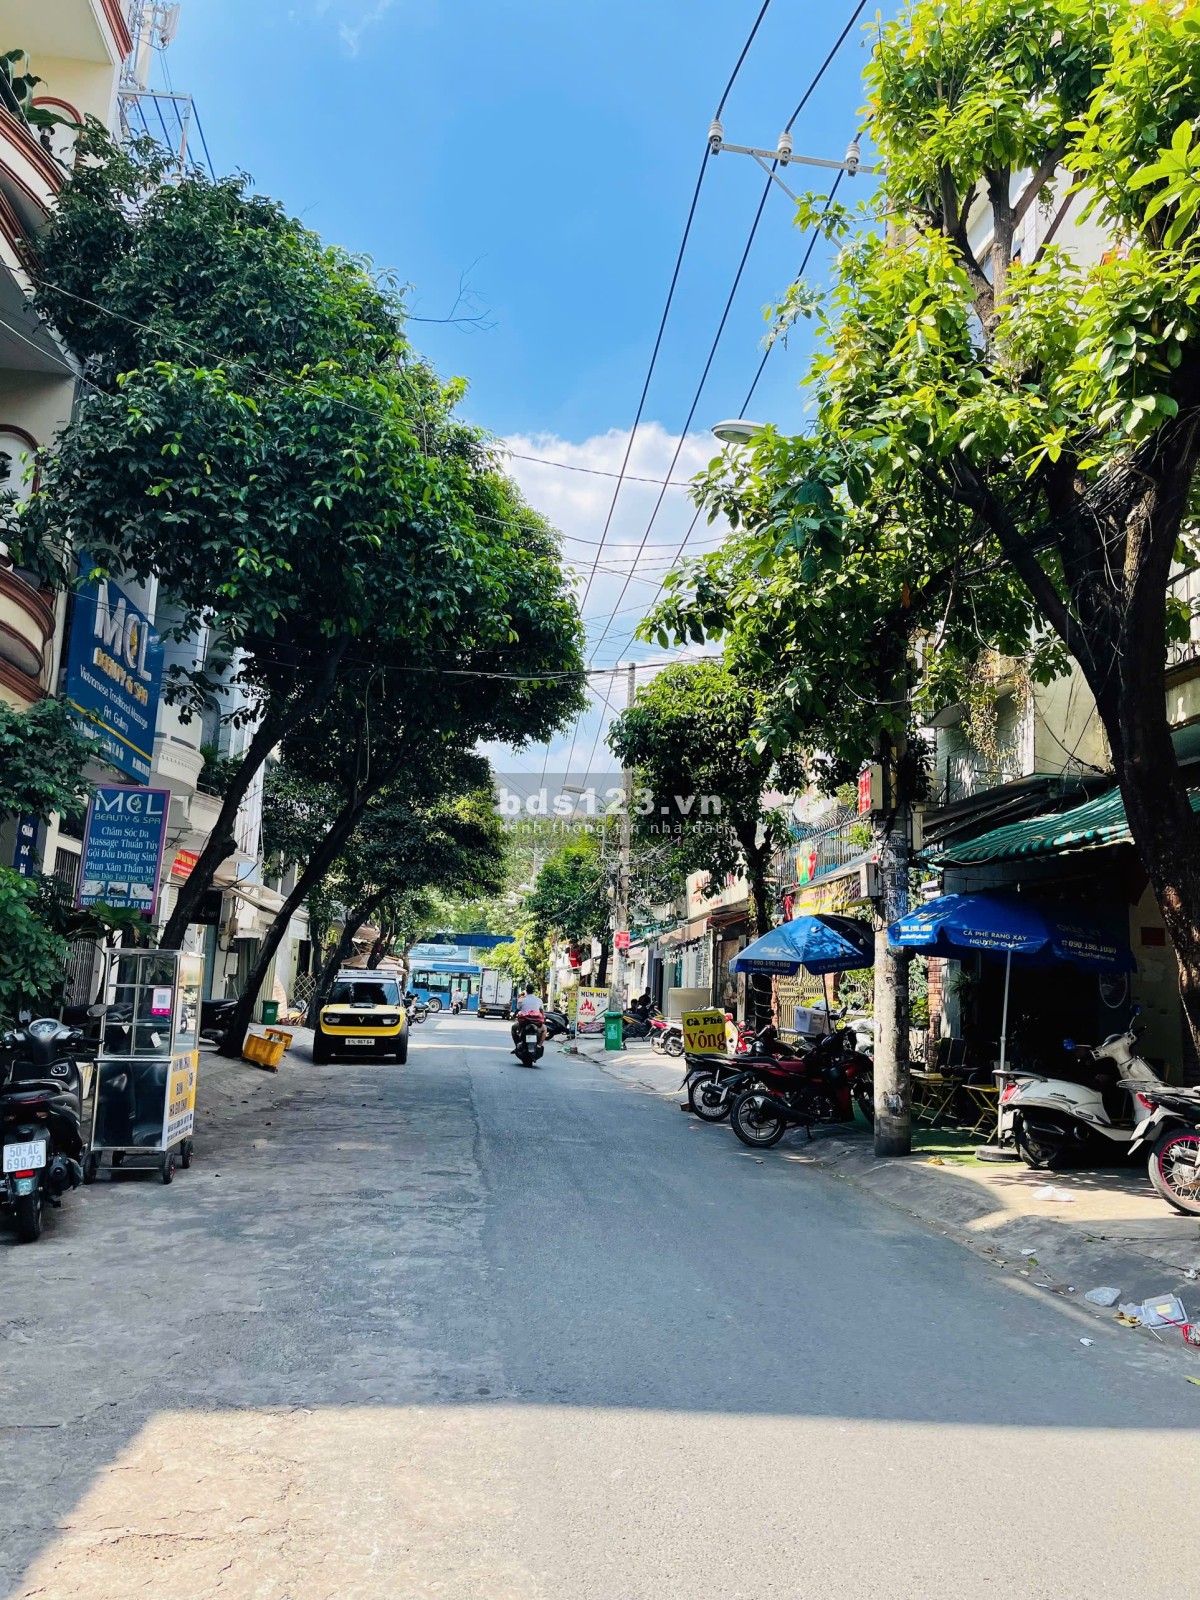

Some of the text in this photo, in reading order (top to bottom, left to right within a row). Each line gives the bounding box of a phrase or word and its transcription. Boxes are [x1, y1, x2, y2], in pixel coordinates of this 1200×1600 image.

[80, 664, 109, 697] Vietnamese
[103, 705, 129, 735] Art Gallery
[94, 790, 163, 815] MCL
[94, 813, 161, 825] BEAUTY & SPA
[123, 828, 138, 837] Sóc
[139, 830, 149, 838] Da
[89, 837, 119, 848] Massage
[141, 853, 157, 861] Sinh
[85, 861, 104, 871] Phun
[991, 932, 1010, 940] RANG
[969, 938, 999, 947] NGUYÊN
[686, 1015, 722, 1026] Cà Phê
[686, 1030, 726, 1050] Võng
[9, 1143, 39, 1158] 50-AC
[6, 1155, 42, 1170] 690.73
